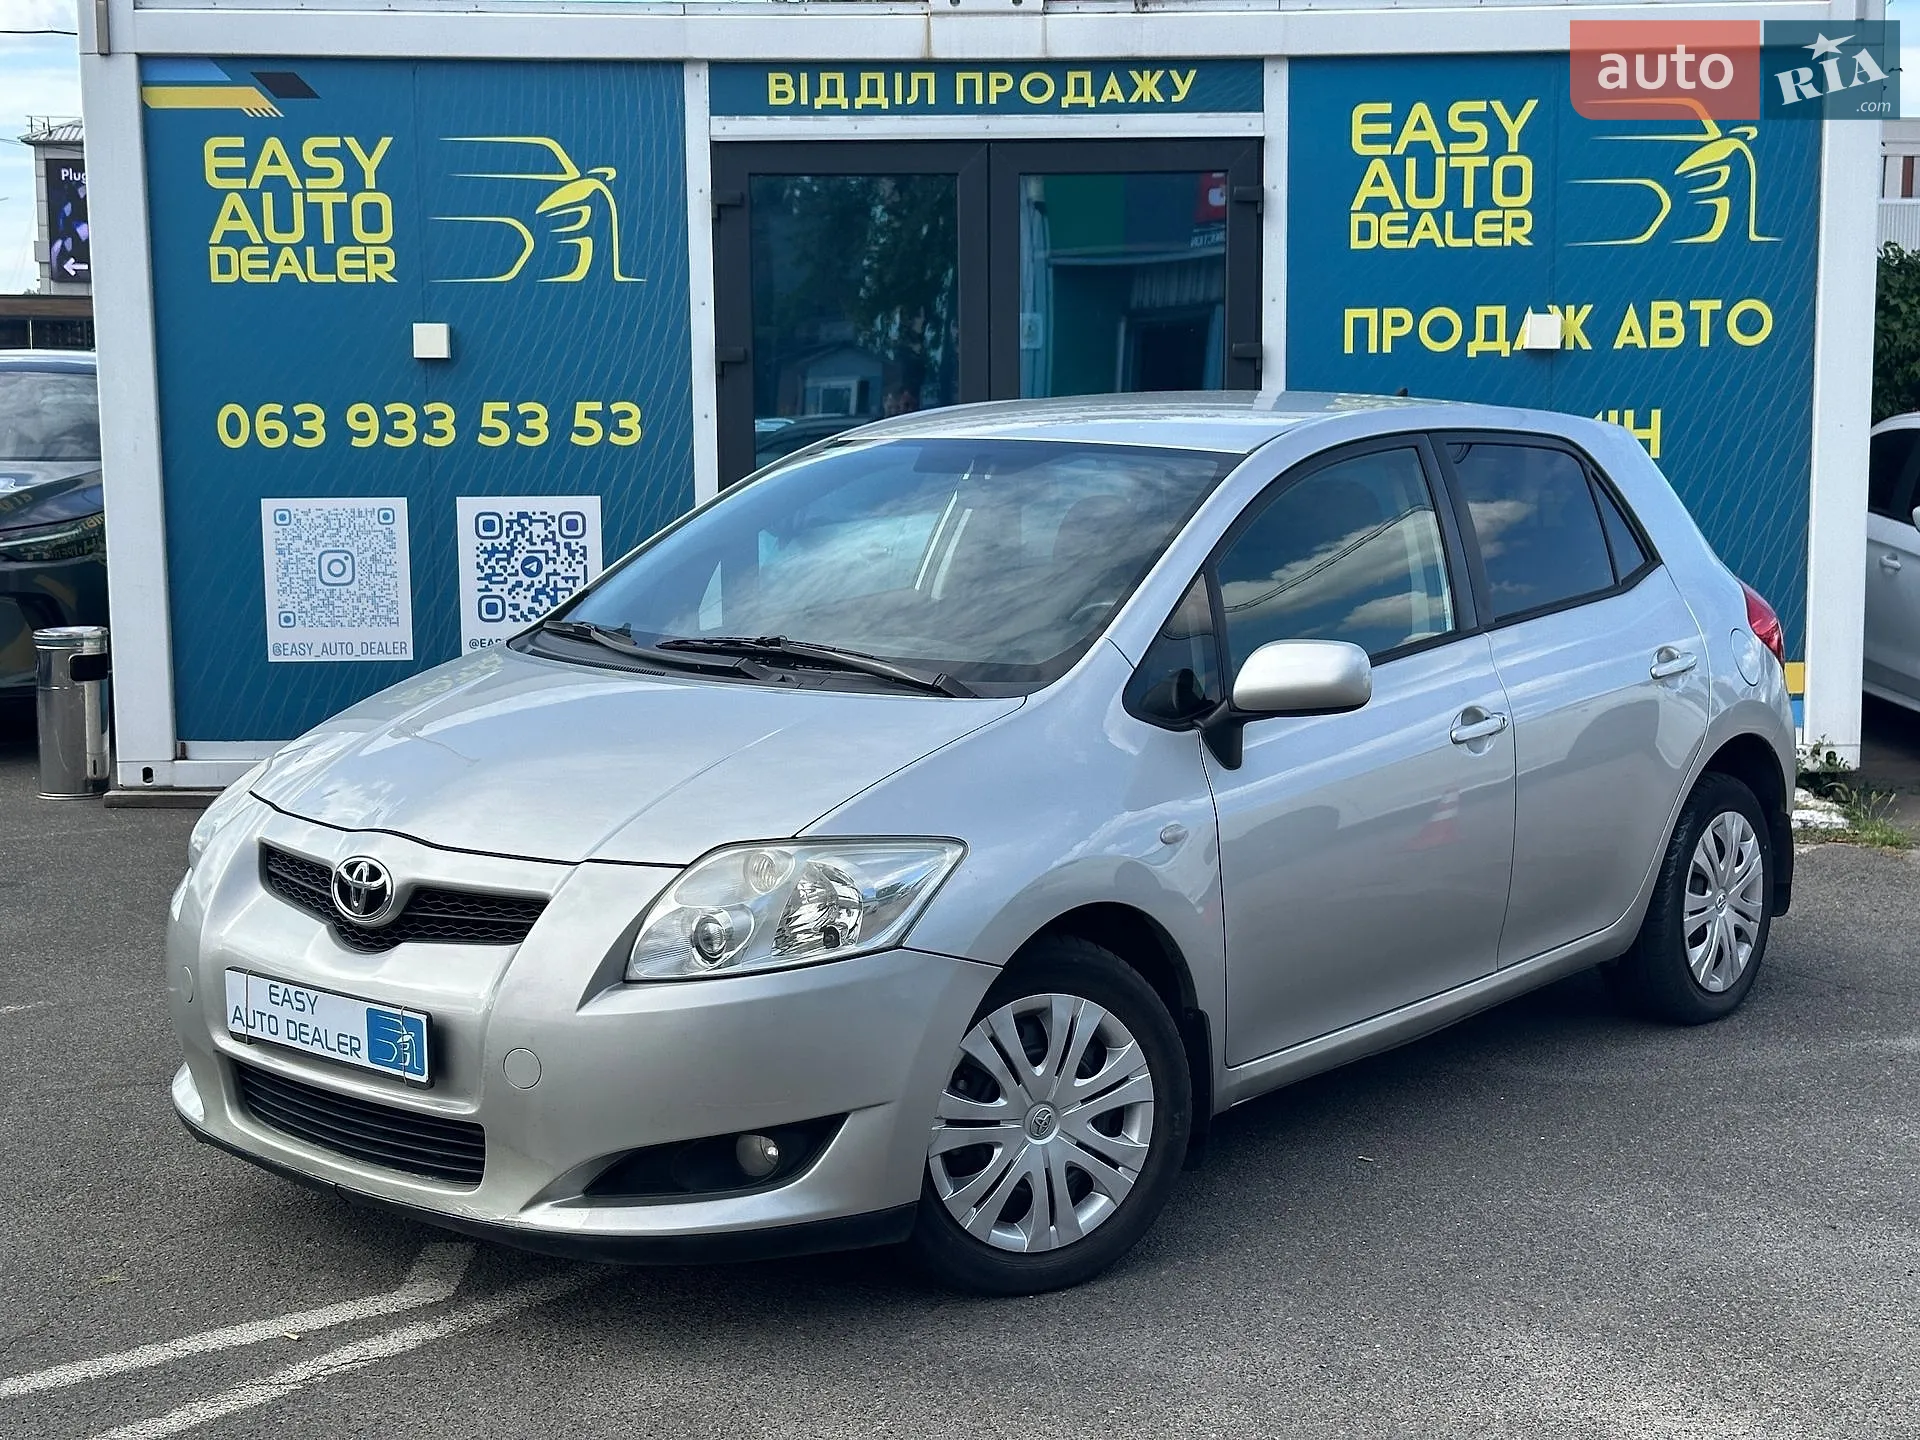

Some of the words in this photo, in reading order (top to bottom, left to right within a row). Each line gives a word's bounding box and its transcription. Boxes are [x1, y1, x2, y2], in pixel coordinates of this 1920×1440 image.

[768, 71, 936, 109] ВІДДІЛ
[956, 69, 1197, 107] ПРОДАЖУ
[1350, 99, 1539, 156] EASY
[203, 136, 394, 190] EASY
[1350, 155, 1534, 211] AUTO
[209, 191, 394, 245] AUTO
[1349, 209, 1534, 249] DEALER
[209, 245, 397, 283] DEALER
[1613, 299, 1774, 349] АВТО
[216, 402, 326, 448] 063
[346, 402, 456, 448] 933
[477, 401, 550, 446] 53
[570, 400, 643, 446] 53
[271, 640, 408, 658] @EASY_AUTO_DEALER
[268, 983, 319, 1016] EASY
[231, 1004, 279, 1037] AUTO
[286, 1018, 362, 1059] DEALER
